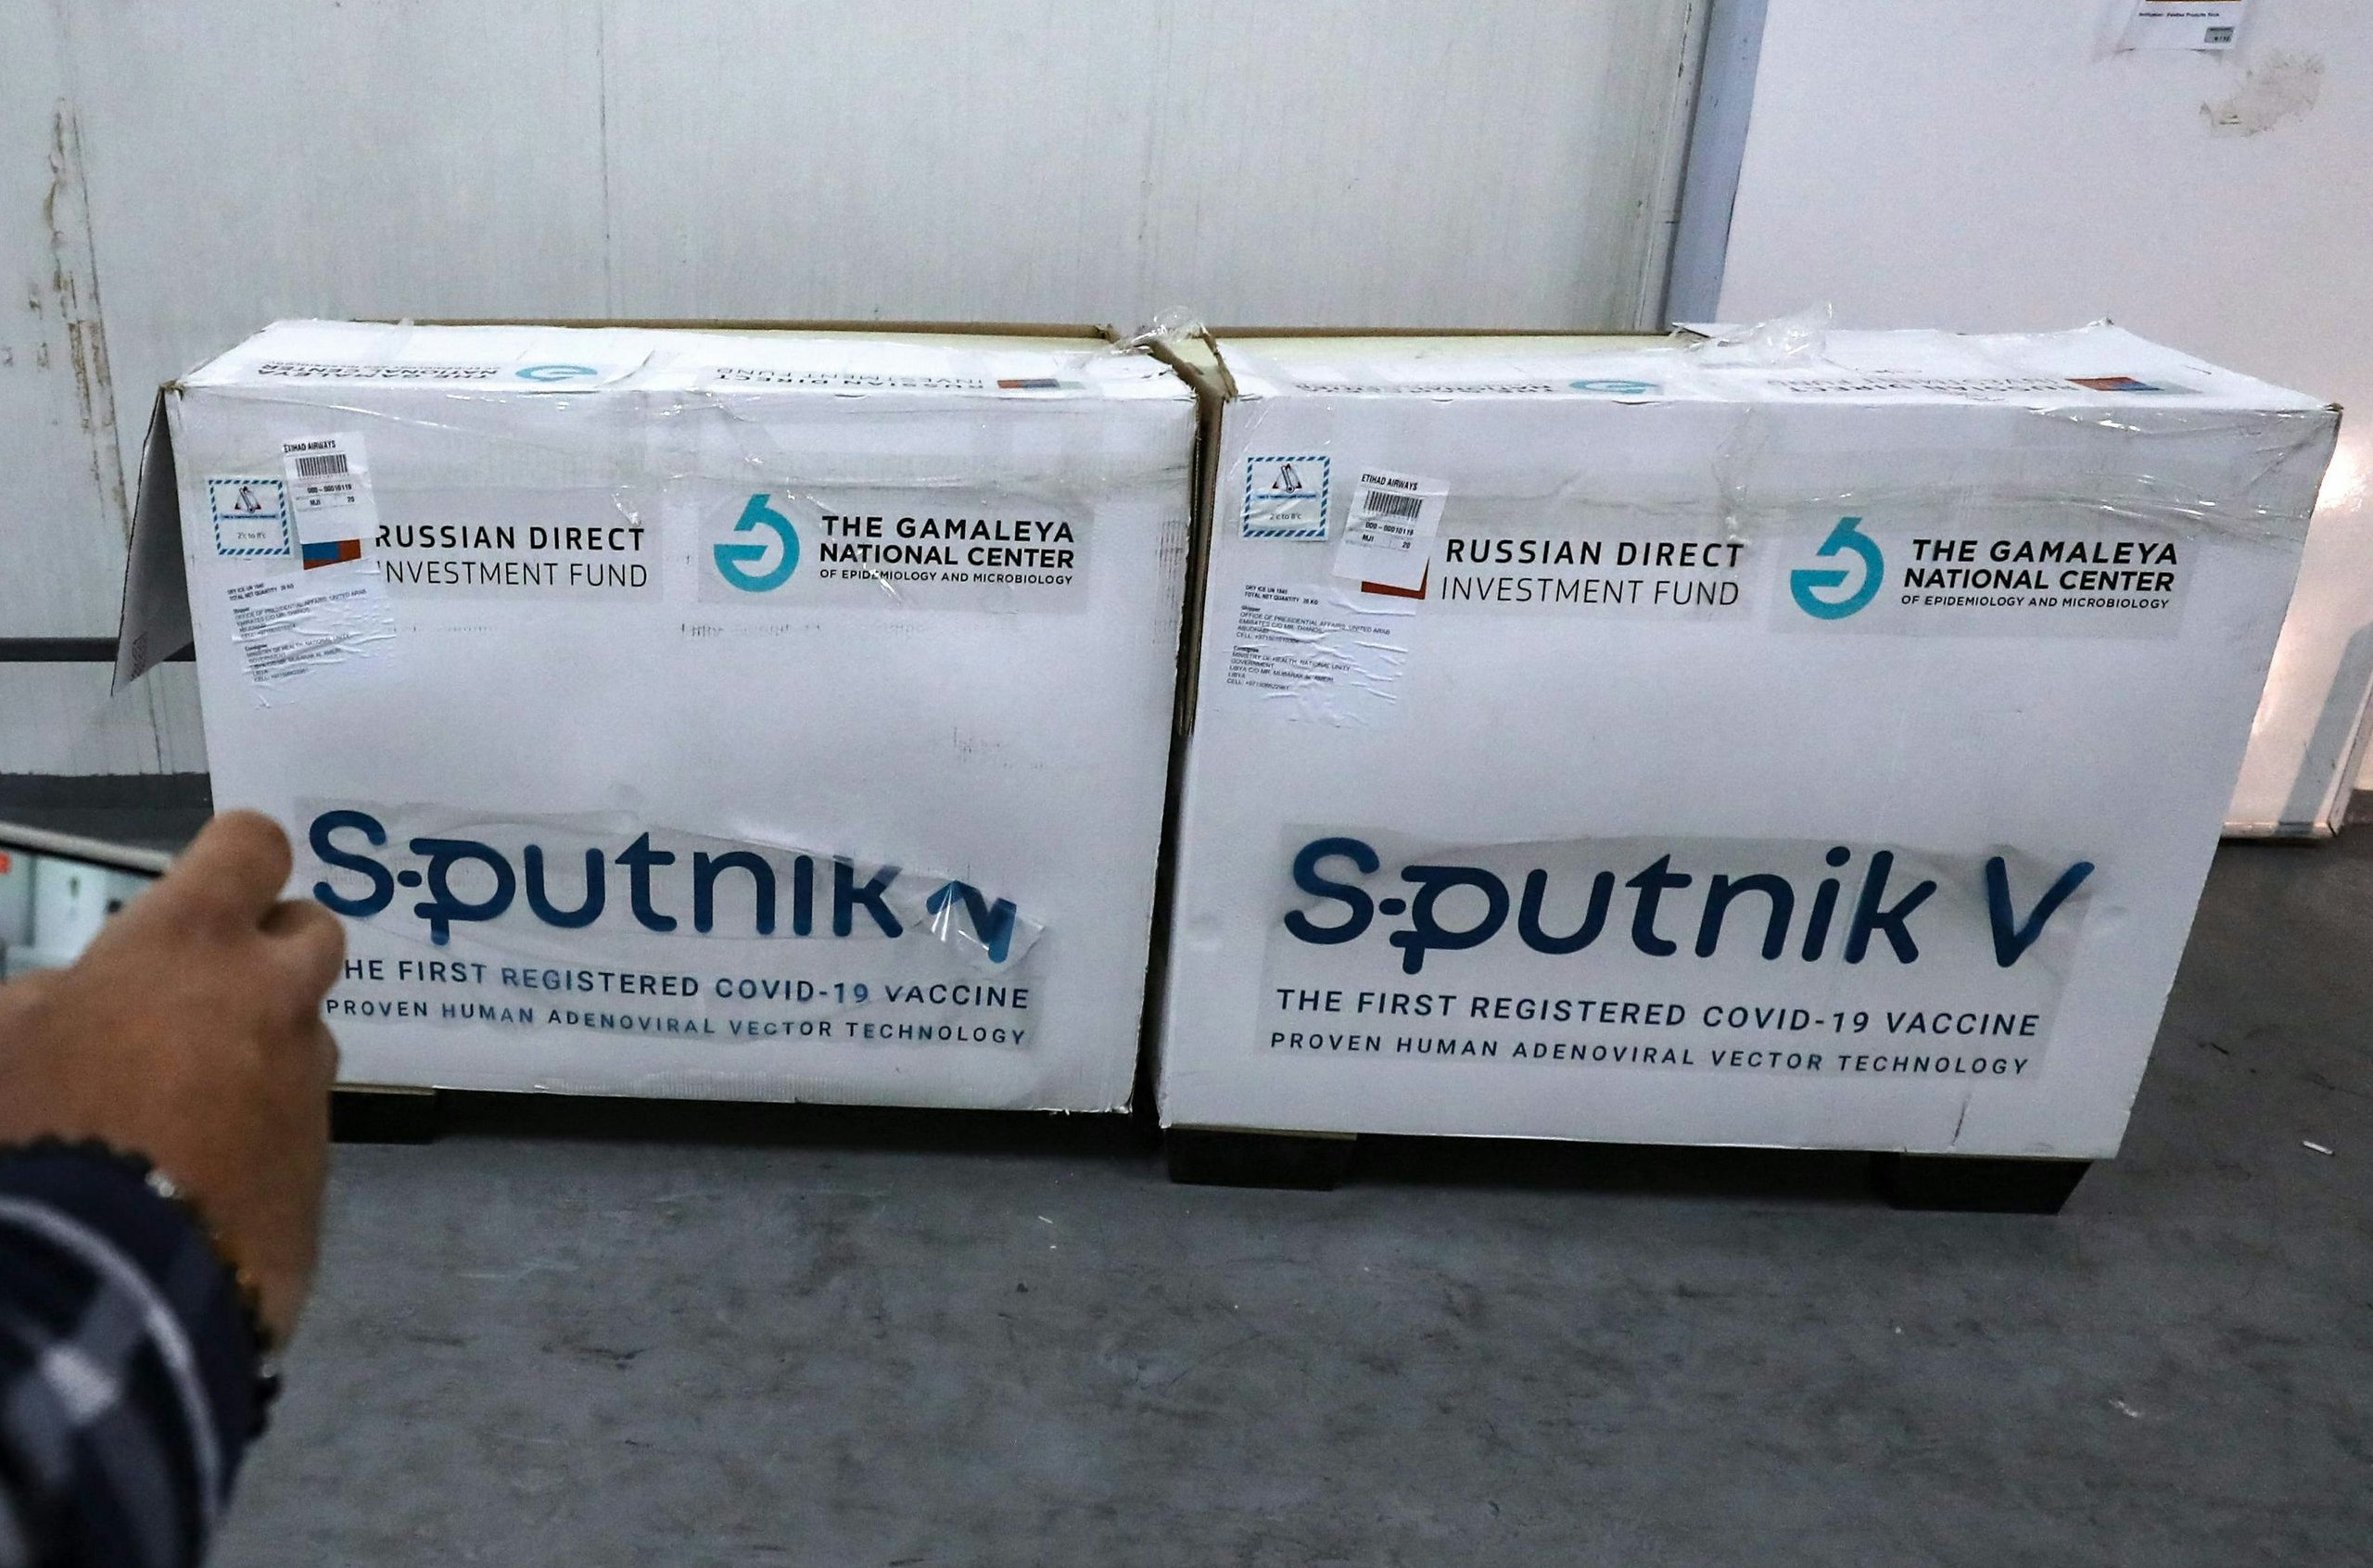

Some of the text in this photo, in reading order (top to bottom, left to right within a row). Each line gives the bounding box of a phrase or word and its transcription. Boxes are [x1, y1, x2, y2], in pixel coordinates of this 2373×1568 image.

[308, 440, 336, 450] AIRWAYS
[1361, 474, 1418, 491] ETIHAD AIRWAYS
[375, 525, 646, 552] RUSSIAN DIRECT
[822, 515, 1075, 544] THE GAMALEYA
[819, 543, 1075, 569] NATIONAL CENTER
[1446, 538, 1745, 567] RUSSIAN DIRECT
[1912, 539, 2178, 565] THE GAMALEYA
[569, 563, 648, 588] FUND
[819, 569, 1073, 586] OF EPIDEMIOLOGY AND MICROBIOLOGY
[1903, 568, 2176, 592] NATIONAL CENTER
[1441, 576, 1739, 605] INVESTMENT FUND
[1901, 595, 2170, 610] OF EPIDEMIOLOGY AND MICROBIOLOGY
[309, 809, 905, 946] Sputnik
[1284, 837, 2096, 975] Sputnik V
[344, 959, 1030, 1009] HE FIRST REGISTERED COVID-19 VACCINE
[326, 999, 1025, 1044] PROVEN HUMAN ADENOVIRAL VECTOR TECHNOLOGY
[1276, 988, 2040, 1037] THE FIRST REGISTERED COVID-19 VACCINE
[1270, 1031, 2028, 1075] PROVEN HUMAN ADENOVIRAL VECTOR TECHNOLOGY
